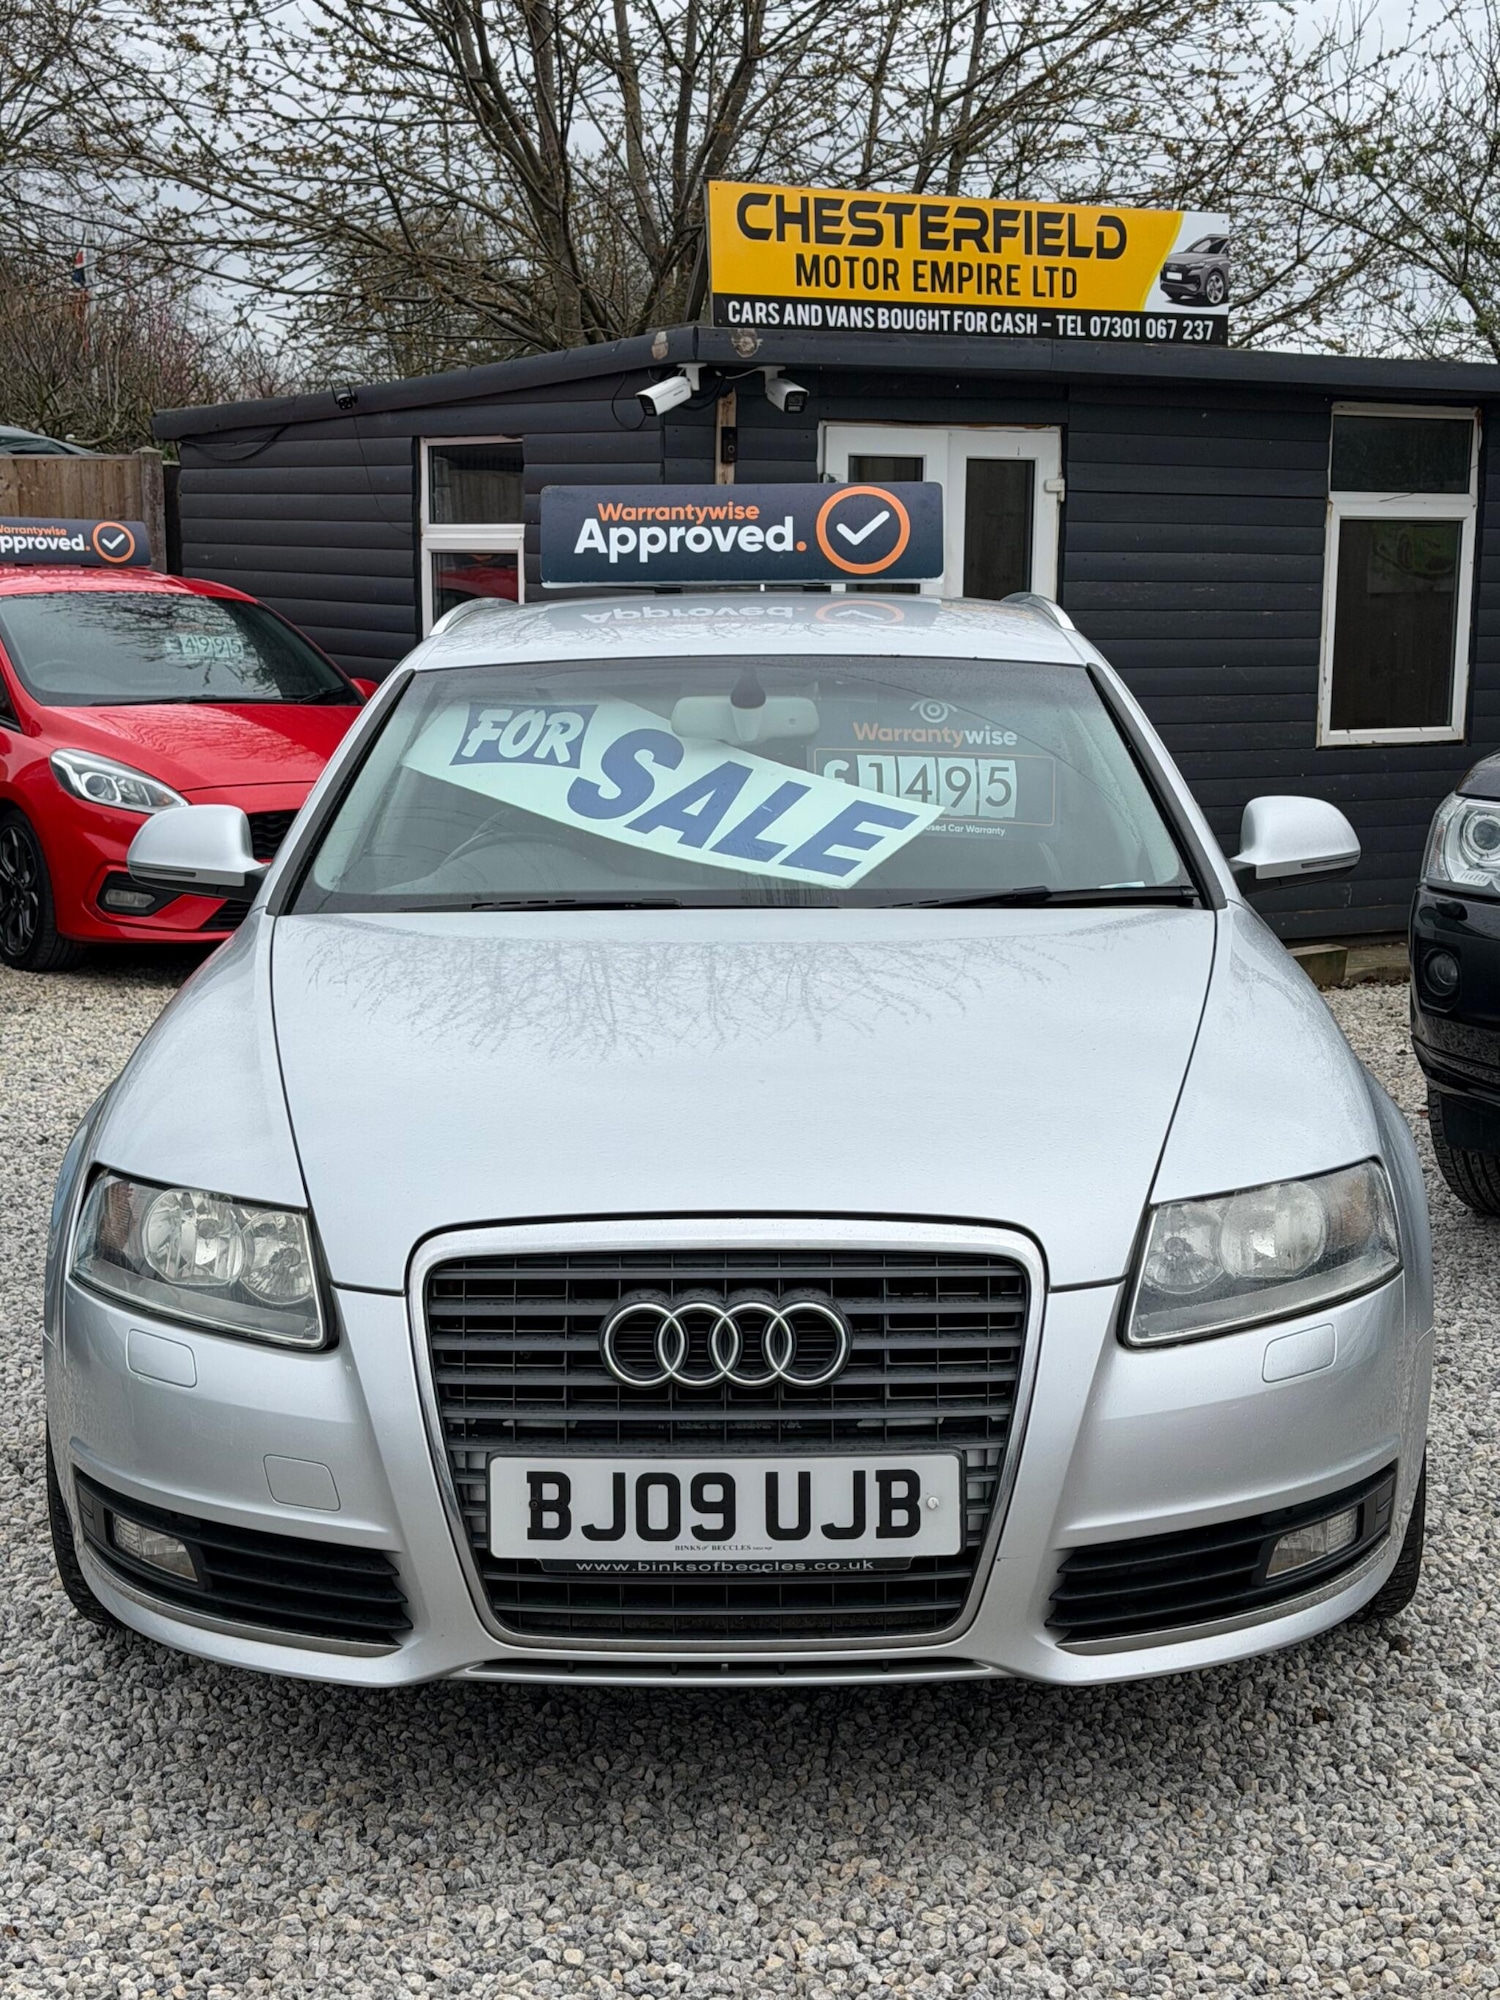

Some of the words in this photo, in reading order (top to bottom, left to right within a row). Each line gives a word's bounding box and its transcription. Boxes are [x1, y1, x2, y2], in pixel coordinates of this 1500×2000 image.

[736, 192, 1128, 260] CHESTERFIELD
[795, 253, 901, 291] MOTOR
[913, 259, 1021, 297] EMPIRE
[1032, 265, 1078, 299] LTD
[728, 301, 780, 325] CARS
[783, 303, 822, 327] AND
[825, 305, 875, 328] VANS
[878, 307, 951, 331] BOUGHT
[953, 310, 990, 333] FOR
[990, 312, 1037, 334] CASH
[1056, 314, 1086, 336] TEL
[1089, 316, 1141, 338] 07301
[1145, 318, 1177, 339] 067
[1182, 320, 1214, 341] 237
[597, 502, 759, 524] Warrantywise
[0, 533, 91, 554] pproved.
[573, 515, 807, 563] Approved.
[853, 722, 1017, 748] Warrantywise
[461, 708, 586, 764] FOR
[567, 727, 920, 878] SALE
[947, 824, 964, 833] Car
[965, 825, 1006, 836] Warranty
[526, 1470, 737, 1542] BJ09
[765, 1469, 921, 1542] UJB
[576, 1559, 875, 1573] www.binksofbeccles.co.uk
